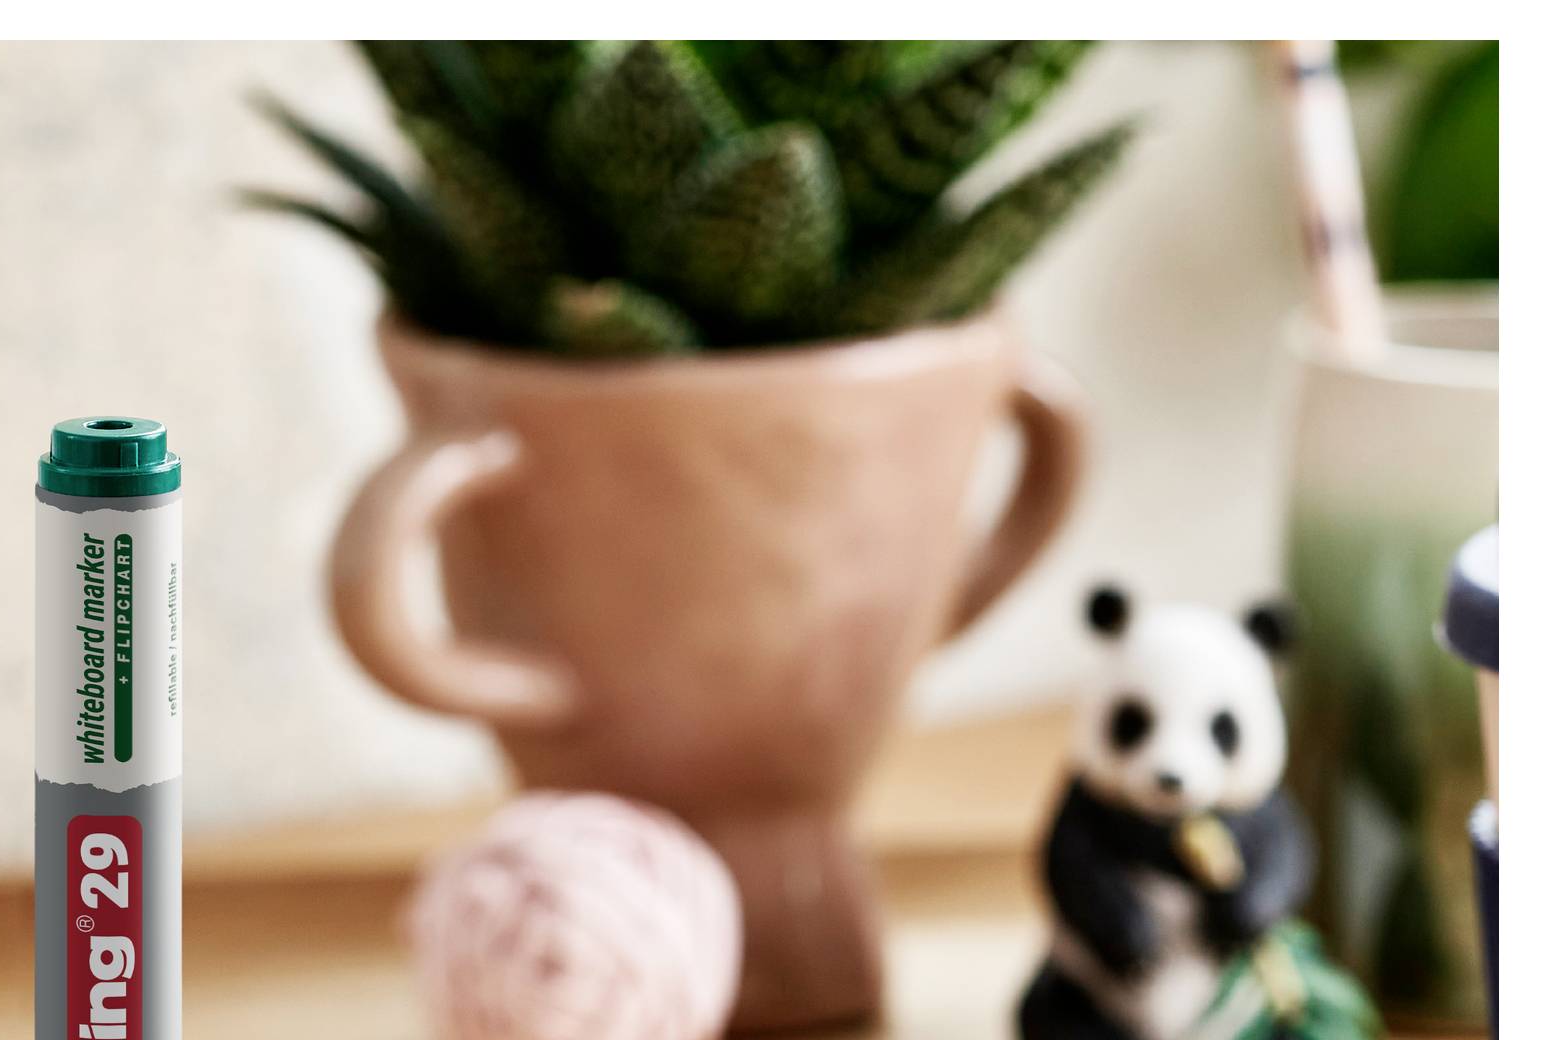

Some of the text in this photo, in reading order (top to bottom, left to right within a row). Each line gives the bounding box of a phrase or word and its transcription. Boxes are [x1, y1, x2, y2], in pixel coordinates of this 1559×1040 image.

[117, 541, 130, 662] FLIPCHART
[168, 562, 177, 641] nachfüllbar
[76, 533, 105, 763] whiteboard marker
[168, 654, 177, 717] refillable
[80, 833, 129, 909] 29
